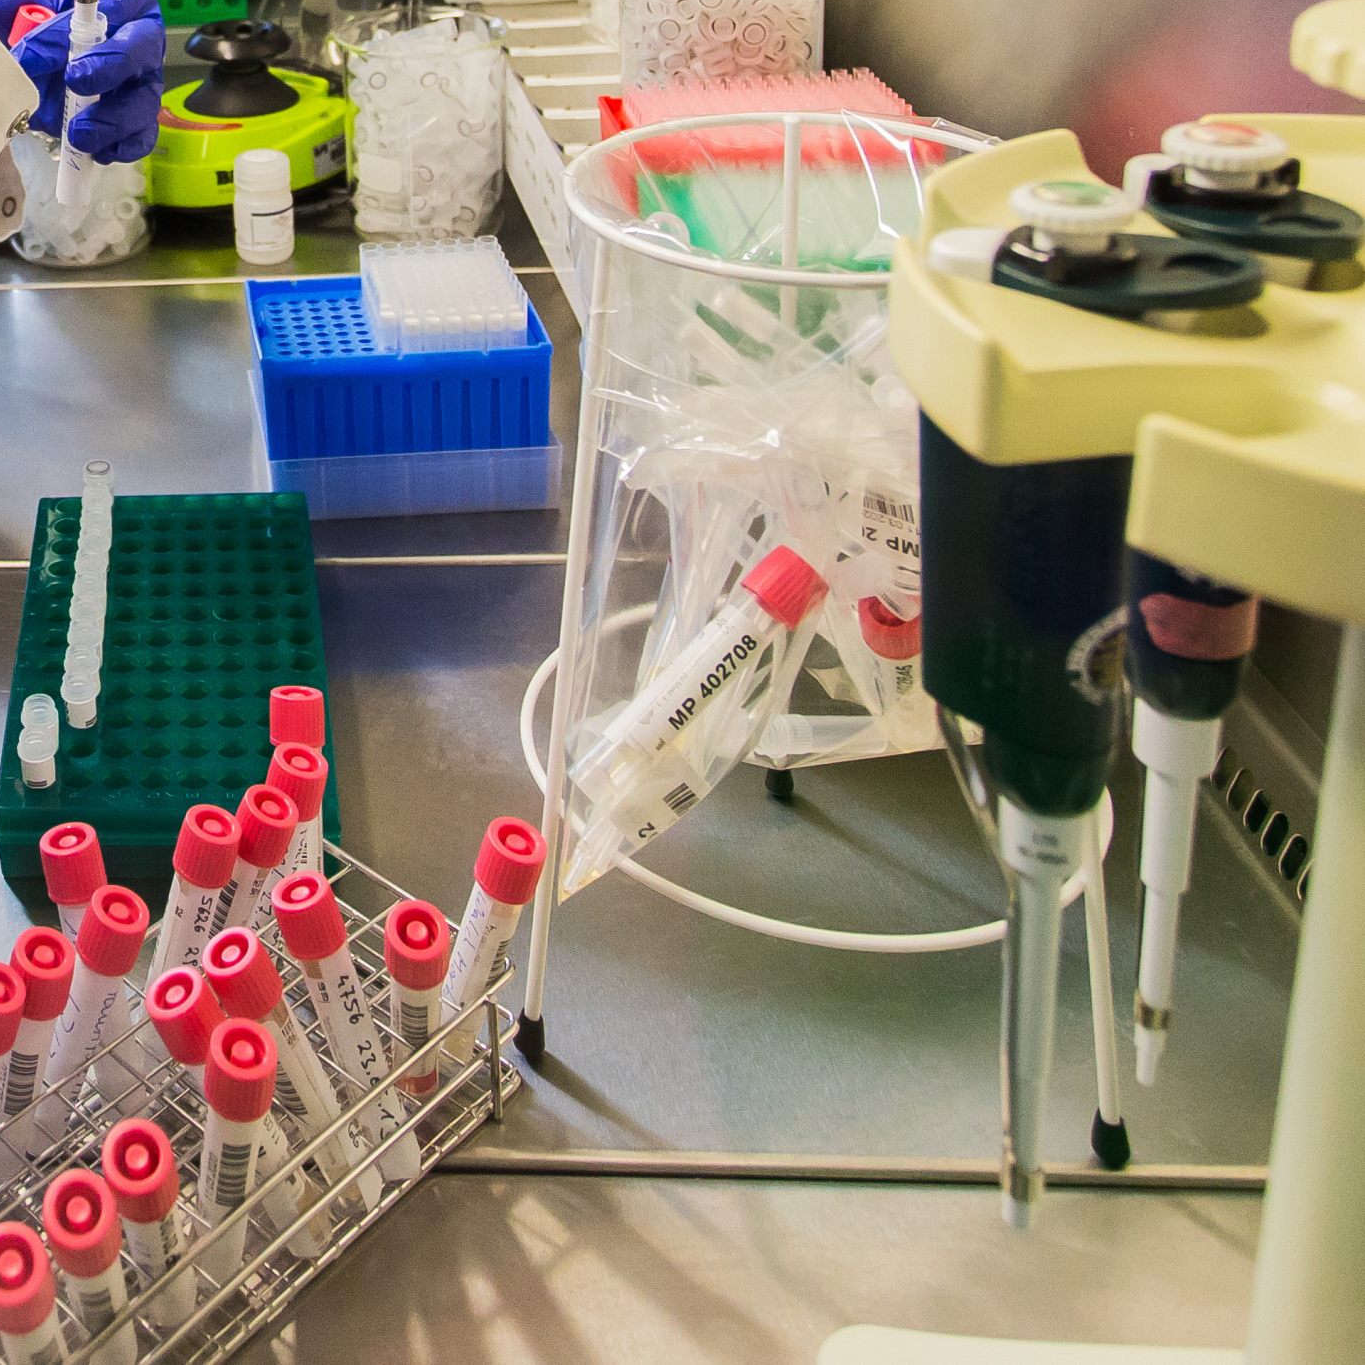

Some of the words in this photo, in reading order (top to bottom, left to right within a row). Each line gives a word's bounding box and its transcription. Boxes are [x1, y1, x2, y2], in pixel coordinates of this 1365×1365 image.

[885, 536, 920, 558] MP
[668, 697, 697, 731] MP
[699, 634, 758, 700] 402708
[193, 895, 214, 934] 5626
[337, 975, 365, 1025] 4756
